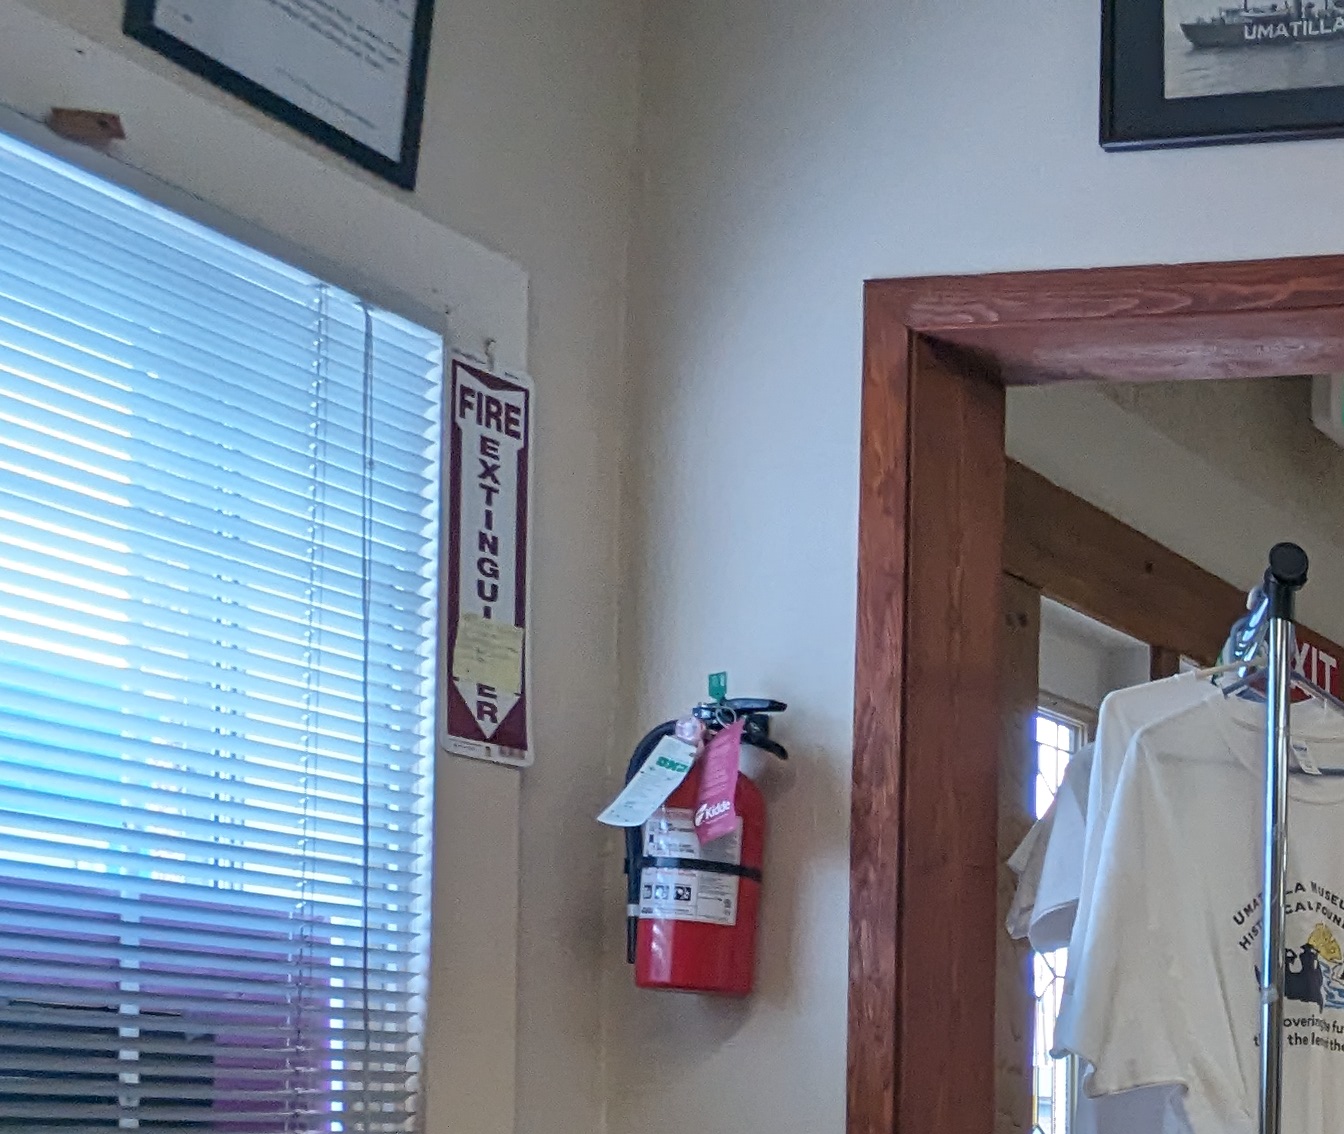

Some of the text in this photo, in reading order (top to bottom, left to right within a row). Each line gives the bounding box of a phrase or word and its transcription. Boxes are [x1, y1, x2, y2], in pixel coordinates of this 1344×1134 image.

[459, 384, 522, 441] FIRE
[705, 800, 732, 820] Kidde
[1287, 1032, 1309, 1046] the
